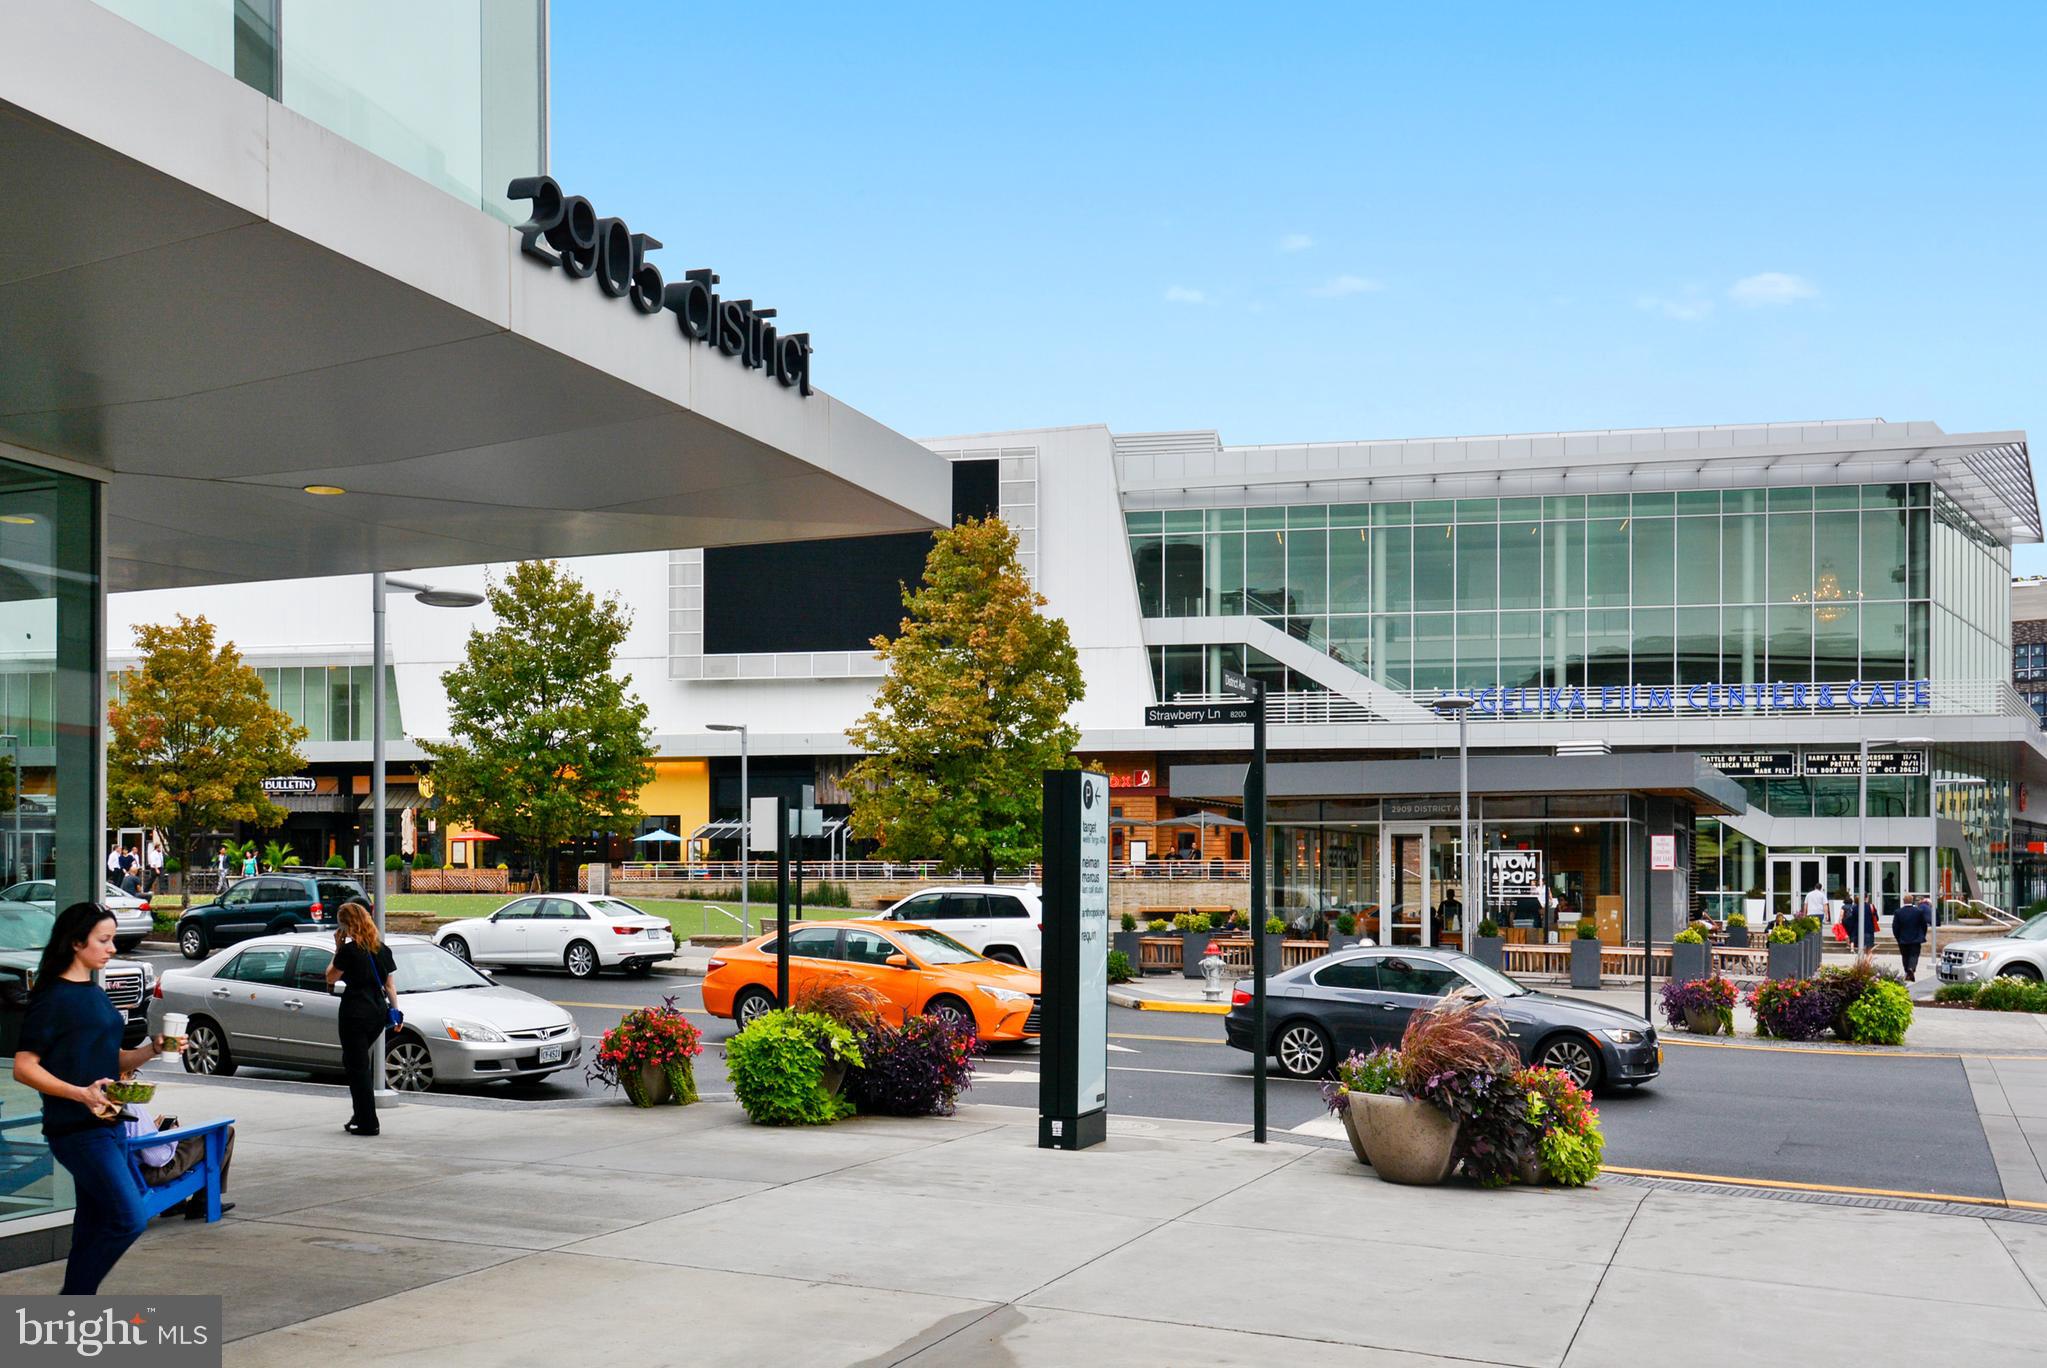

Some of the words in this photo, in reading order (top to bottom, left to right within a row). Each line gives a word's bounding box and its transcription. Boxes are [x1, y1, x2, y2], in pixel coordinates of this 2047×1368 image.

[507, 176, 665, 314] 2905
[665, 268, 813, 396] district
[1601, 686, 1674, 712] FILM
[1687, 683, 1808, 710] CENTER
[1818, 684, 1834, 708] &
[1847, 680, 1932, 708] CAFE
[1149, 710, 1205, 722] Strawberry
[1208, 709, 1221, 719] Ln
[265, 780, 310, 789] BULLETIN
[1414, 805, 1452, 813] DISTRICT
[1083, 821, 1097, 836] target
[1082, 856, 1100, 869] neiman
[1492, 856, 1536, 869] MOM
[1082, 873, 1100, 883] marcus
[1500, 871, 1537, 884] POP
